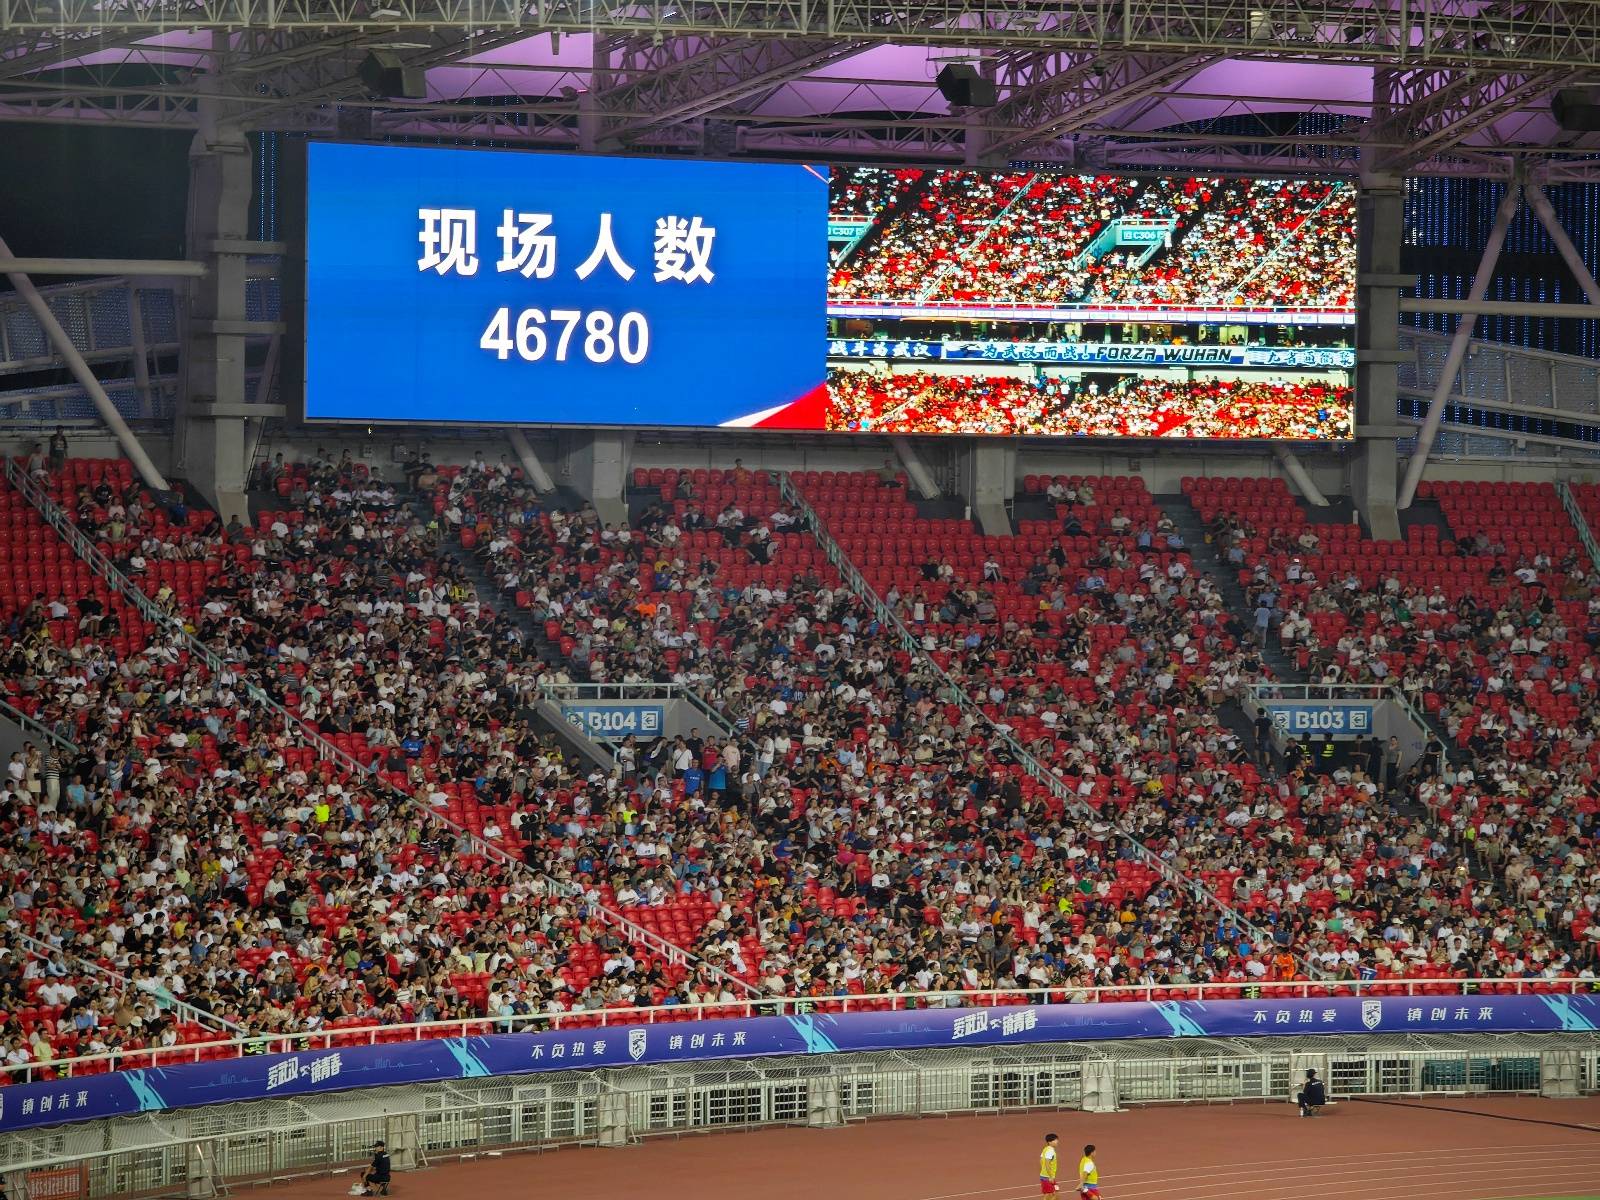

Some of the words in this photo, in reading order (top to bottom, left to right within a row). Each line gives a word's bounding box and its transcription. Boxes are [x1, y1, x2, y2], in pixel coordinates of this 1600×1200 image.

[418, 208, 716, 285] 现场人数
[480, 308, 649, 364] 46780
[1096, 346, 1157, 362] FORZA
[1163, 347, 1233, 363] WUHAN
[589, 711, 637, 731] B104
[1296, 711, 1344, 729] B103
[1254, 1009, 1337, 1024] 不负热爱
[1407, 1006, 1493, 1022] 镇创未来
[531, 1040, 606, 1060] 不负热爱
[669, 1031, 747, 1051] 镇创未来
[22, 1090, 89, 1115] 镇创未来
